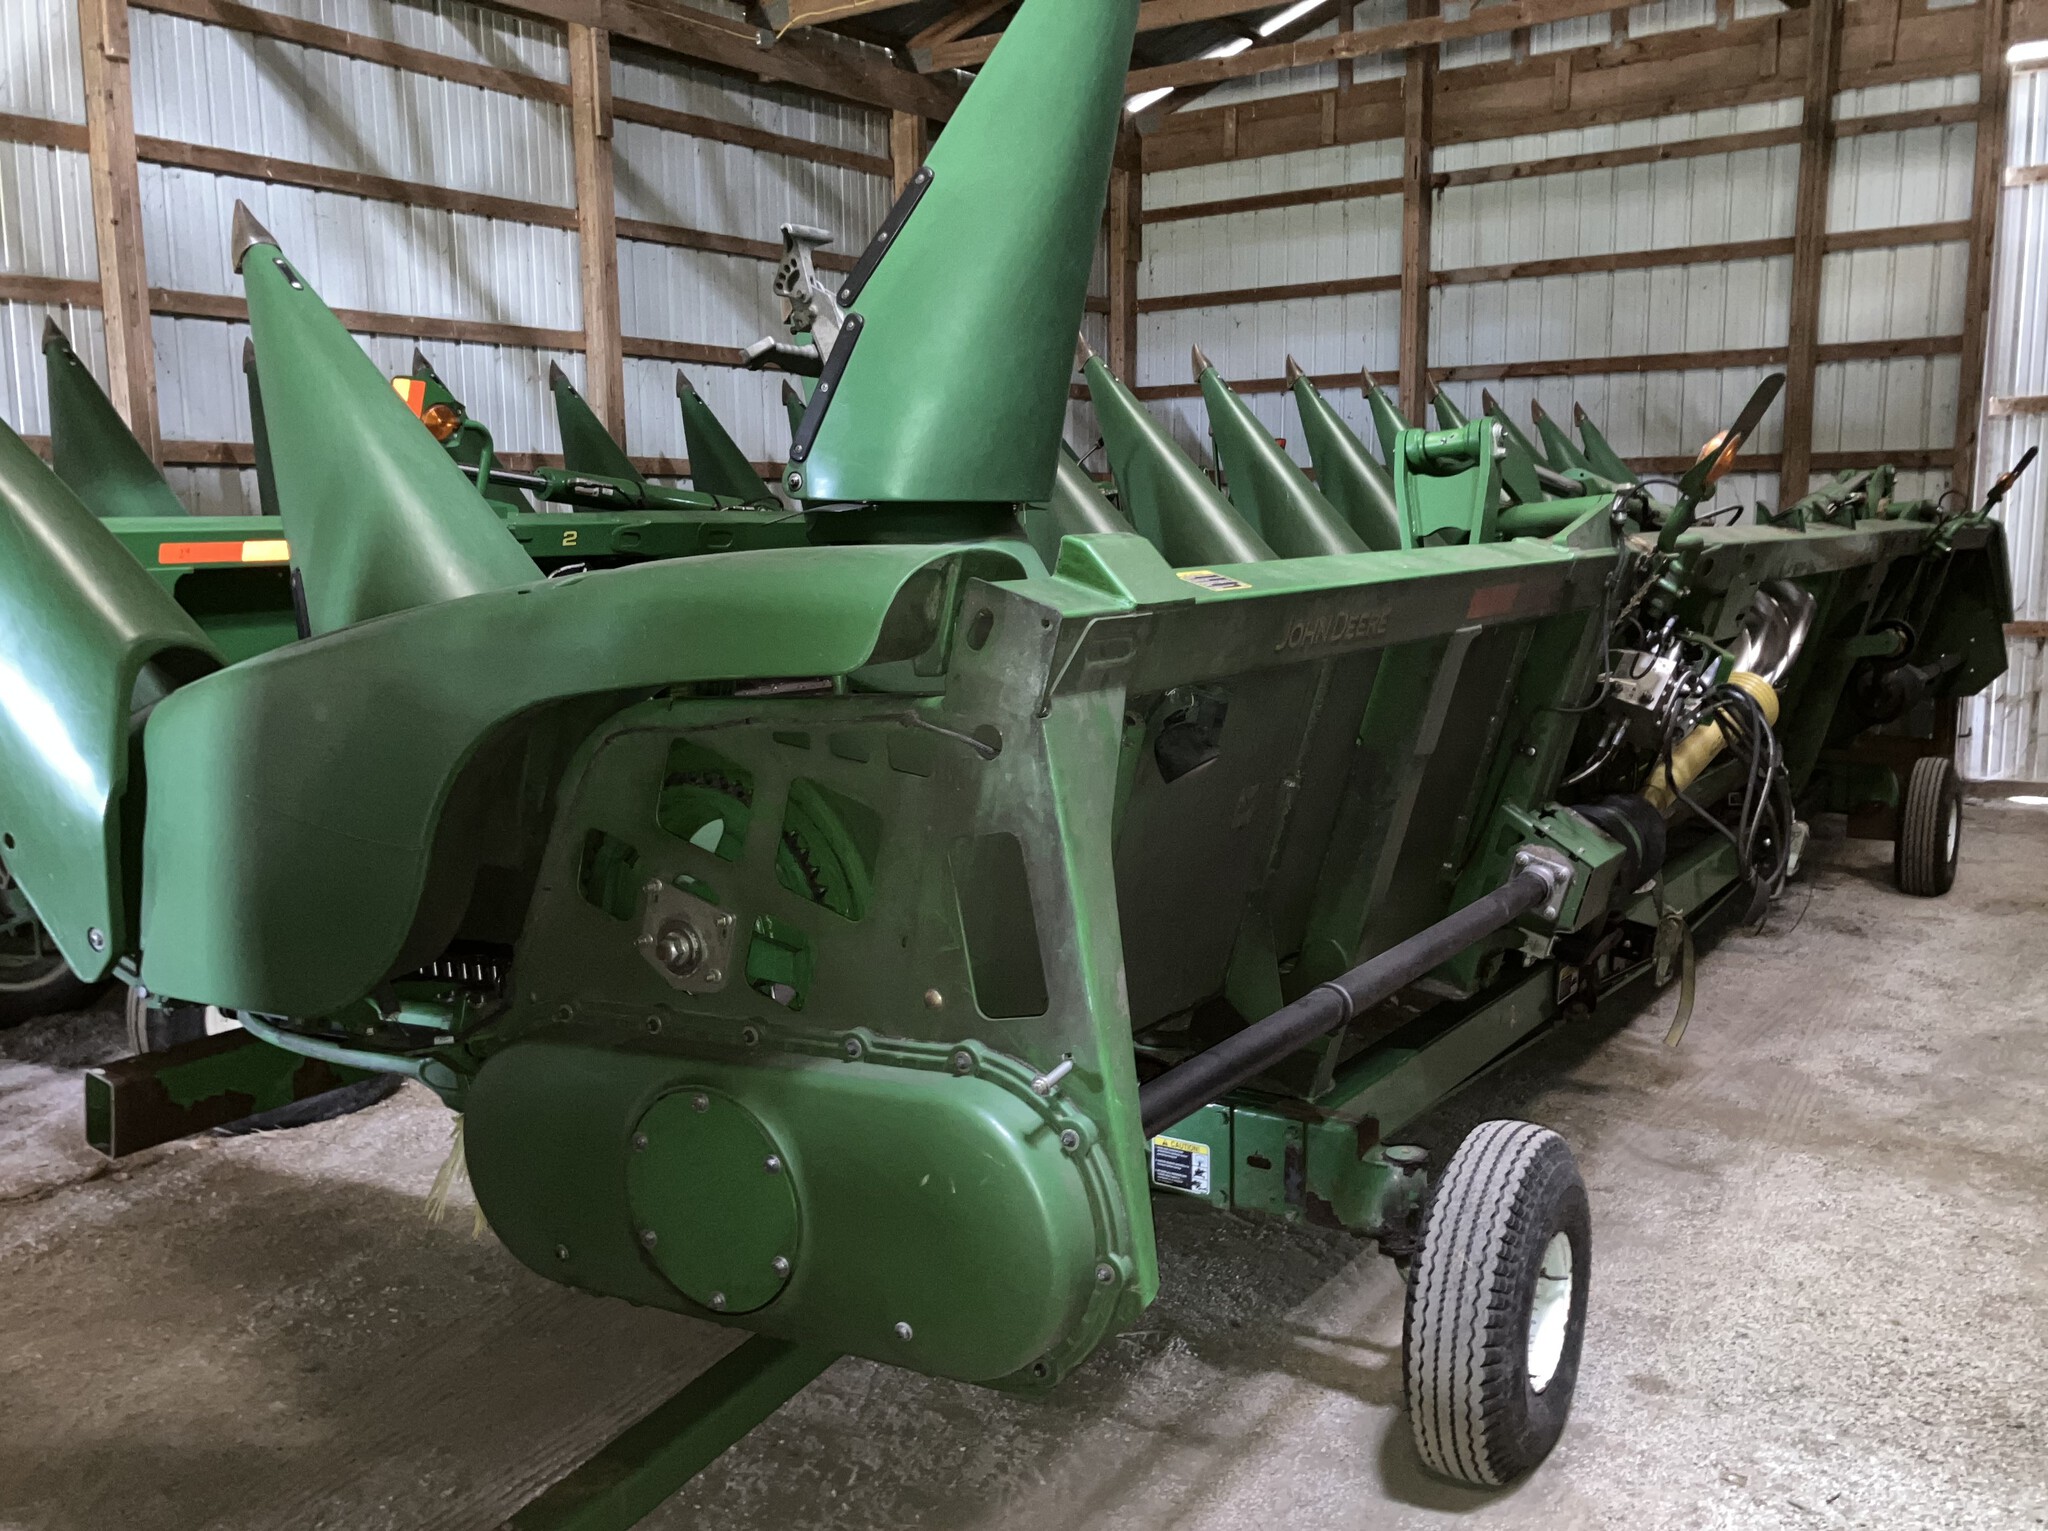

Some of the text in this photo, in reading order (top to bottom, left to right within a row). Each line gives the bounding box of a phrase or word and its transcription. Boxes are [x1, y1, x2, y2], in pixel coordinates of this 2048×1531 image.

[562, 530, 578, 546] 2
[1274, 609, 1391, 651] JOHN DEERE
